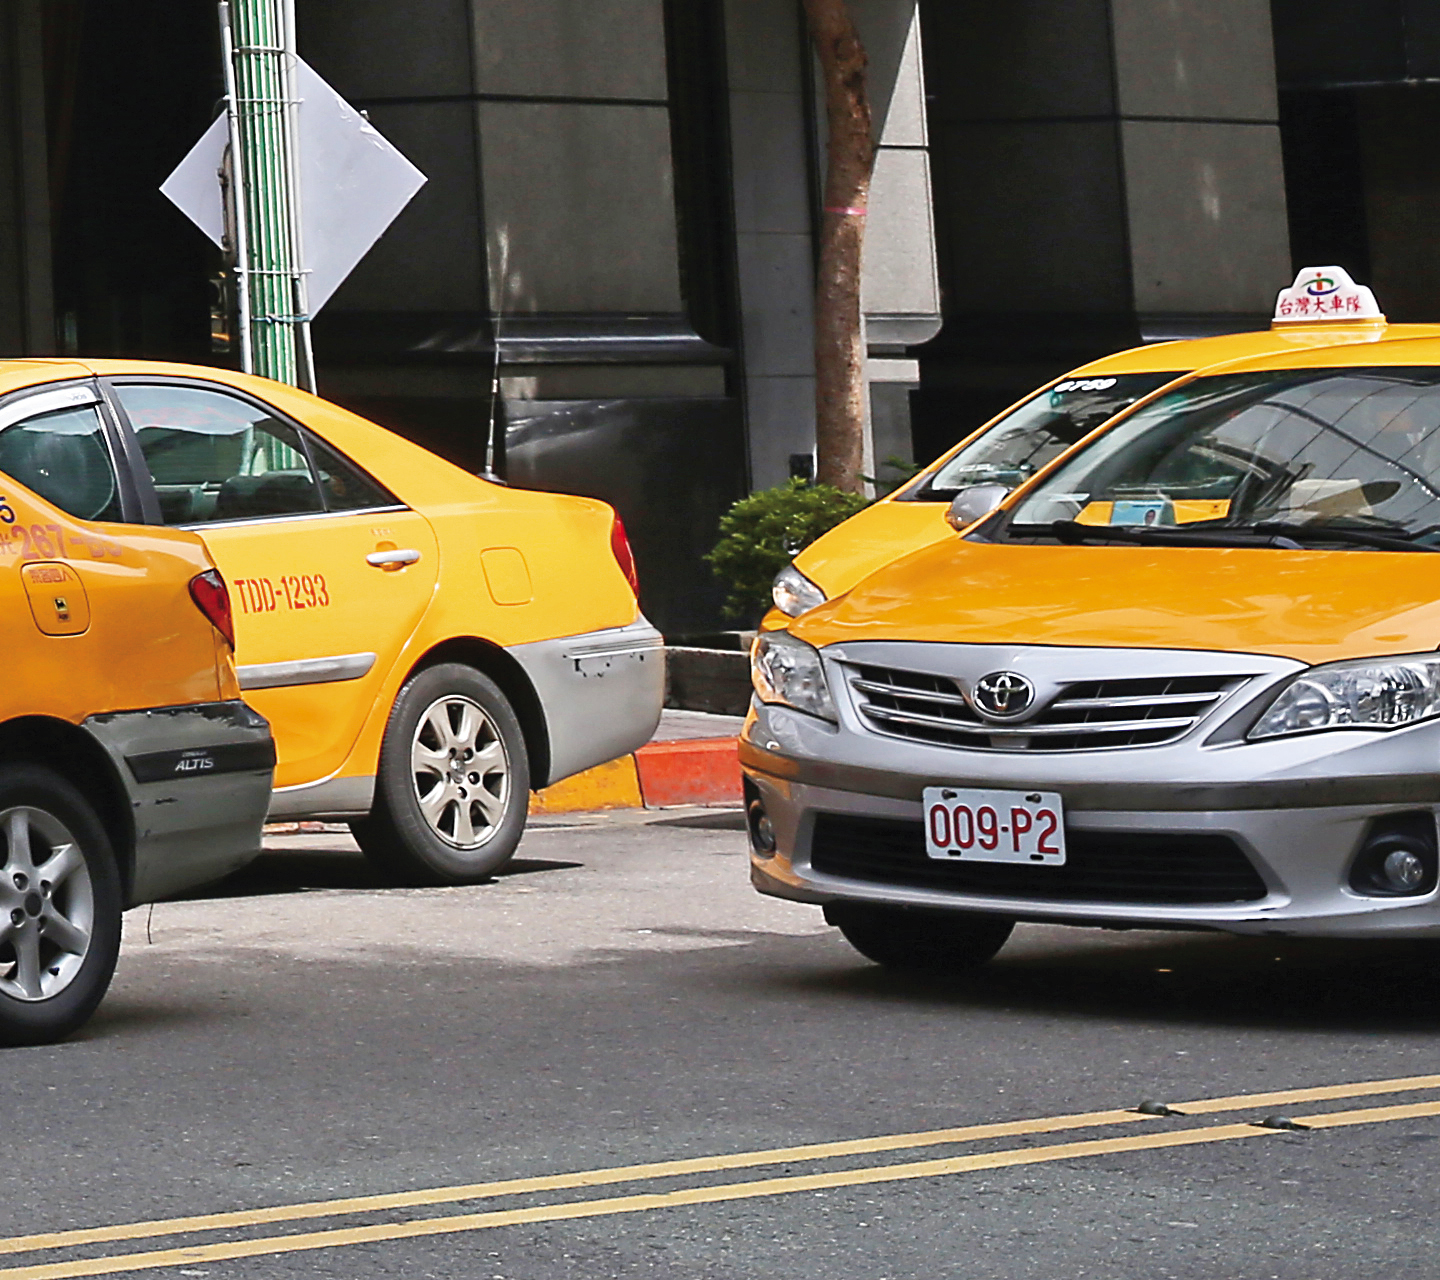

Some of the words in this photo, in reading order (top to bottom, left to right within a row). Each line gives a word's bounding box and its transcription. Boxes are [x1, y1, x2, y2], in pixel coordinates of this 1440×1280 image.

[1280, 295, 1362, 316] 台灣大車隊
[234, 573, 329, 614] TDD-1293
[174, 758, 214, 772] ALTIS
[929, 803, 1060, 855] 009-P2
